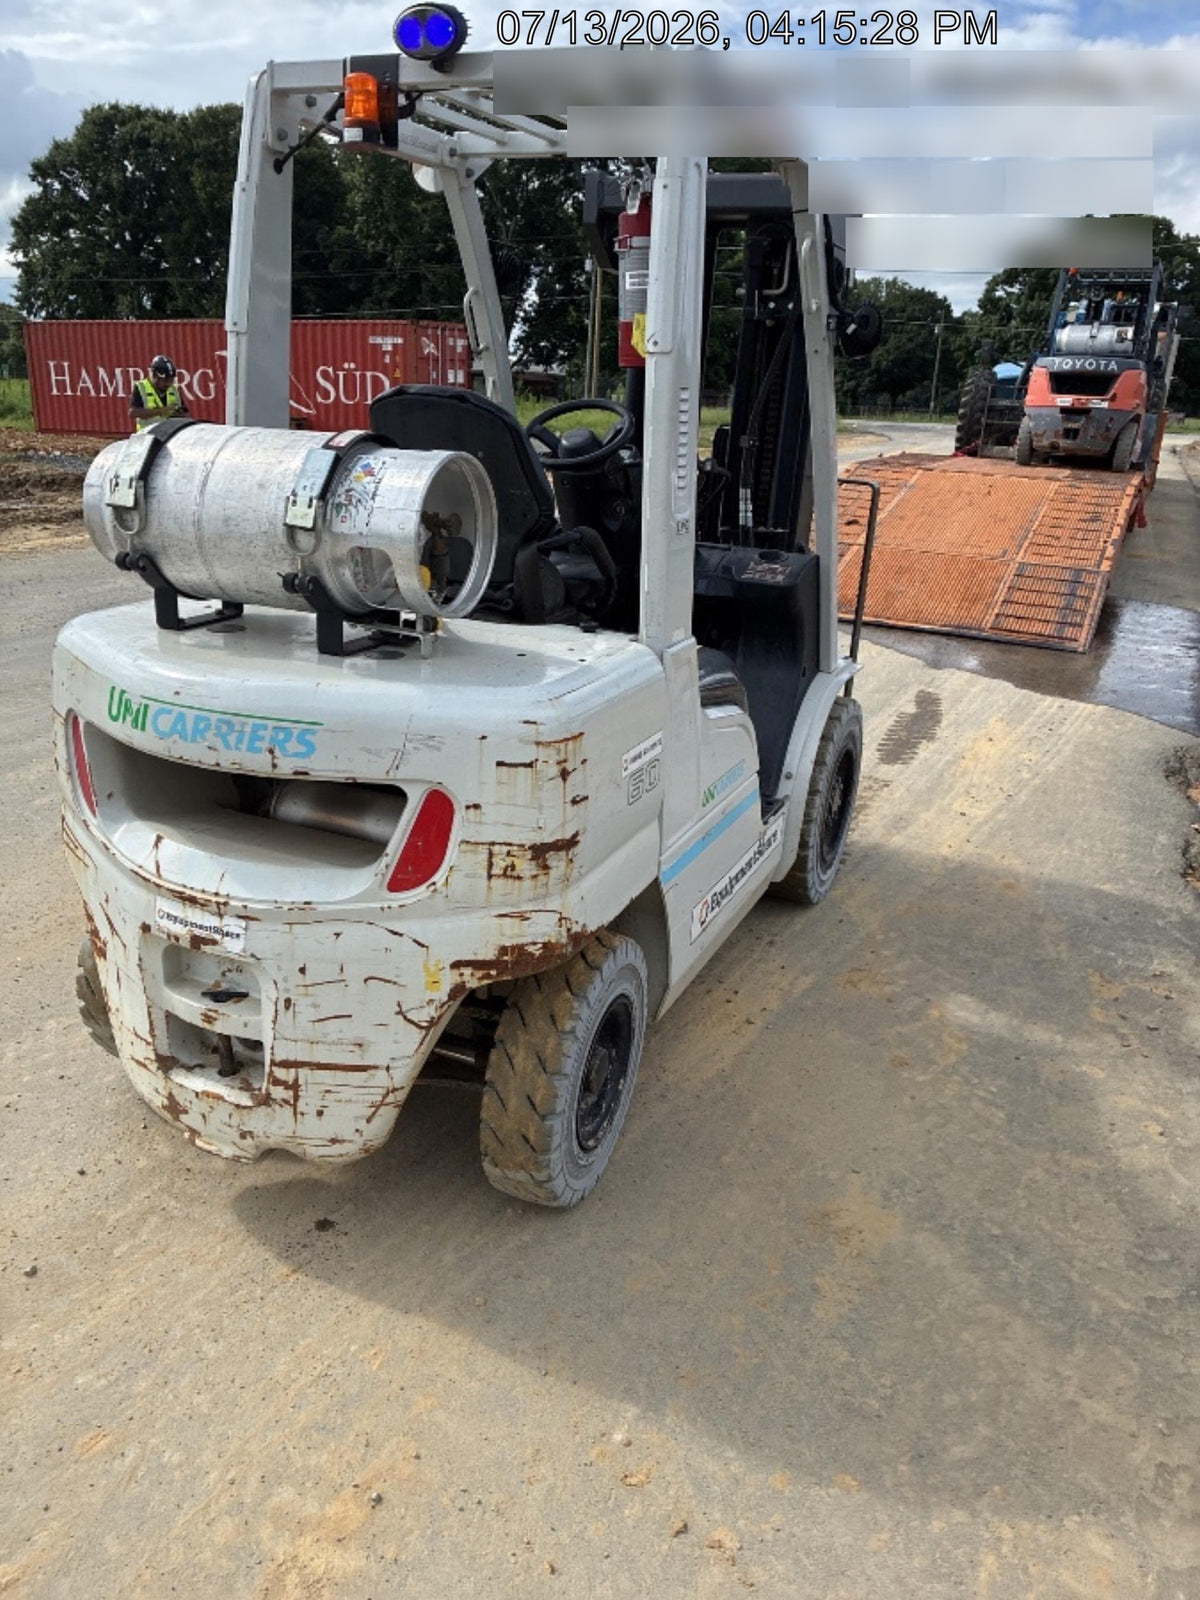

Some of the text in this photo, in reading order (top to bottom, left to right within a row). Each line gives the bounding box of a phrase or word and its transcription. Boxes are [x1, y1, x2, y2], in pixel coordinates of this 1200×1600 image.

[1053, 358, 1118, 371] TOYOTA
[48, 360, 390, 405] HAMBRG SÜD
